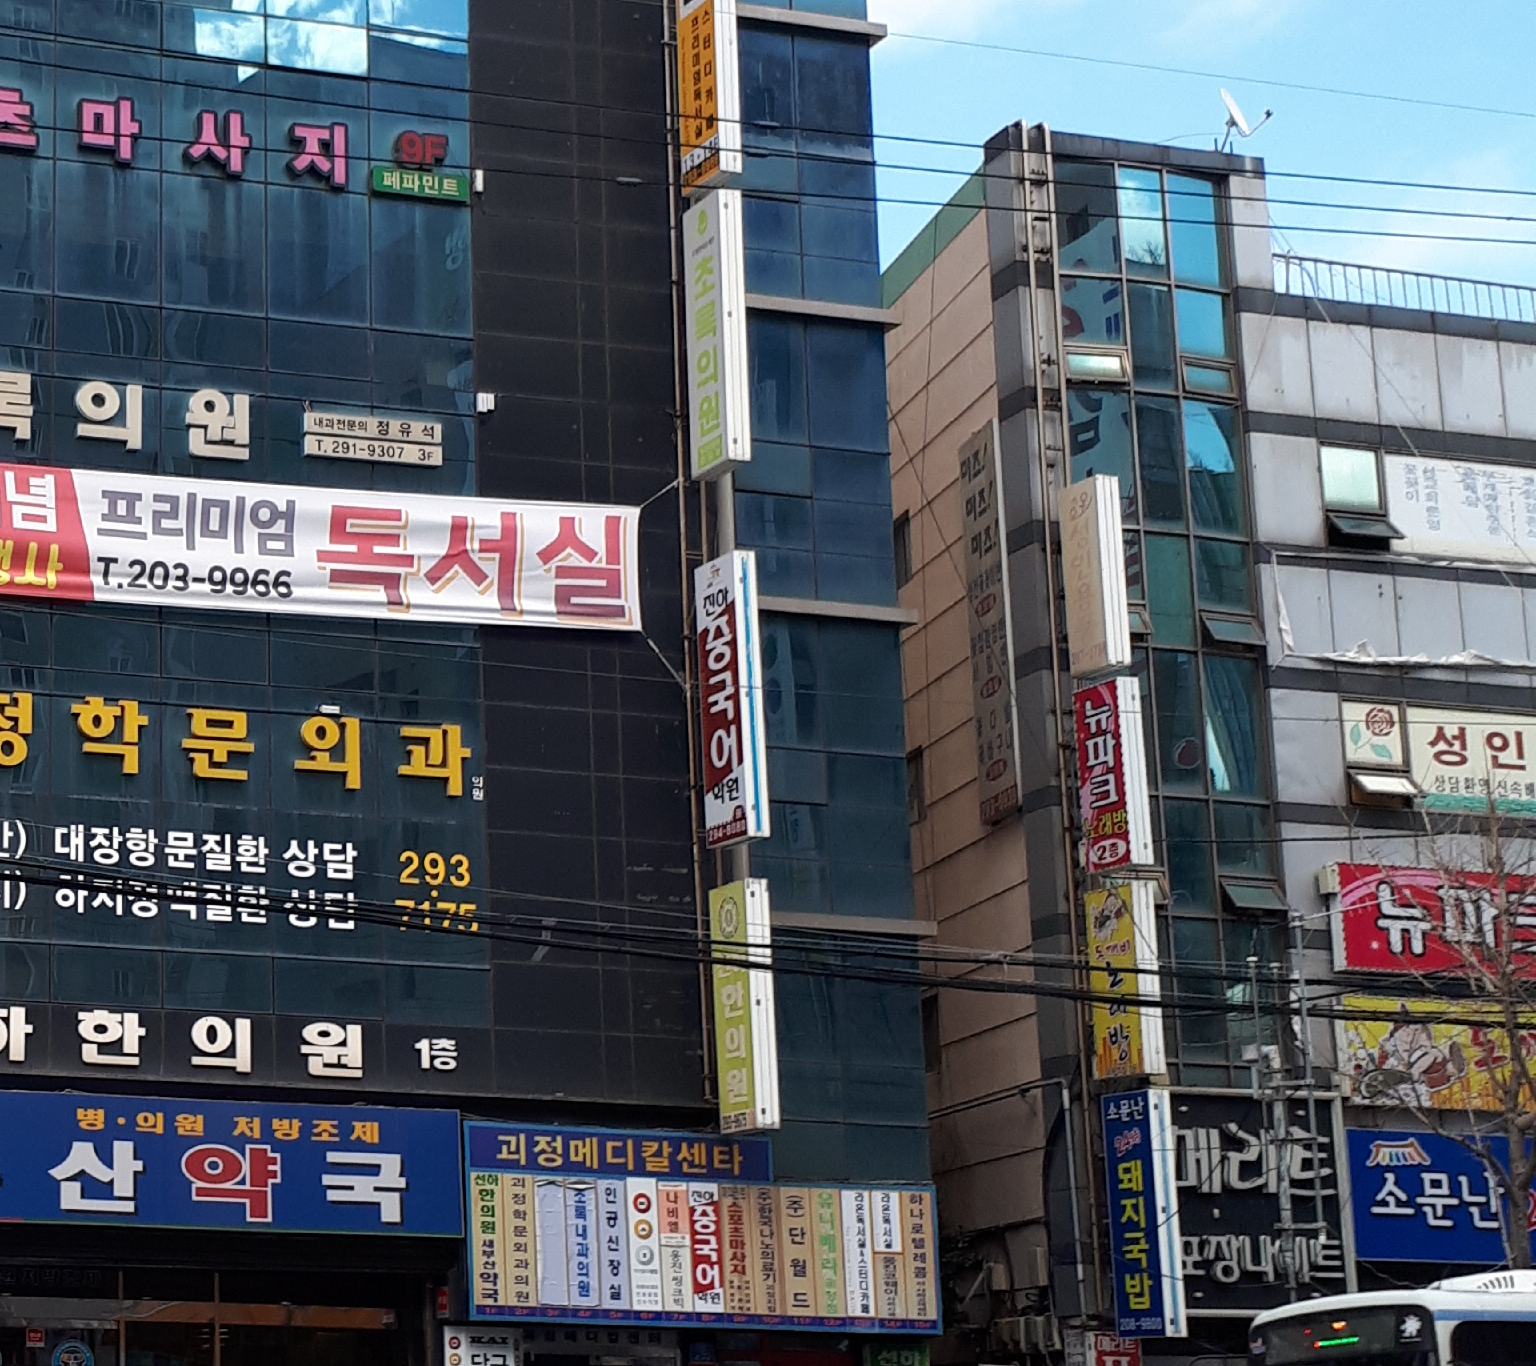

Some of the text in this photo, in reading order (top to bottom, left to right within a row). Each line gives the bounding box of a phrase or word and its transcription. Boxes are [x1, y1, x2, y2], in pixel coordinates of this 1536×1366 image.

[398, 130, 448, 166] 9F
[382, 171, 460, 196] 페파민트
[313, 416, 435, 440] 내과전문의 정유석
[332, 440, 405, 459] 291-9307
[417, 448, 434, 462] 3F
[97, 489, 296, 558] 프리미엄
[315, 504, 634, 627] 독서실
[705, 614, 739, 772] 중국어
[1084, 700, 1120, 810] 뉴파크
[1427, 725, 1527, 772] 성인
[54, 824, 358, 881] 대장항문질환 상담
[398, 850, 472, 888] 293
[413, 1037, 460, 1072] 1층
[232, 1115, 380, 1144] 처방조제
[1106, 1096, 1144, 1122] 소문난
[496, 1132, 744, 1177] 괴정메디칼센타
[1369, 1171, 1504, 1230] 소문난
[692, 1204, 721, 1290] 중국어
[1117, 1158, 1154, 1311] 돼지국밥
